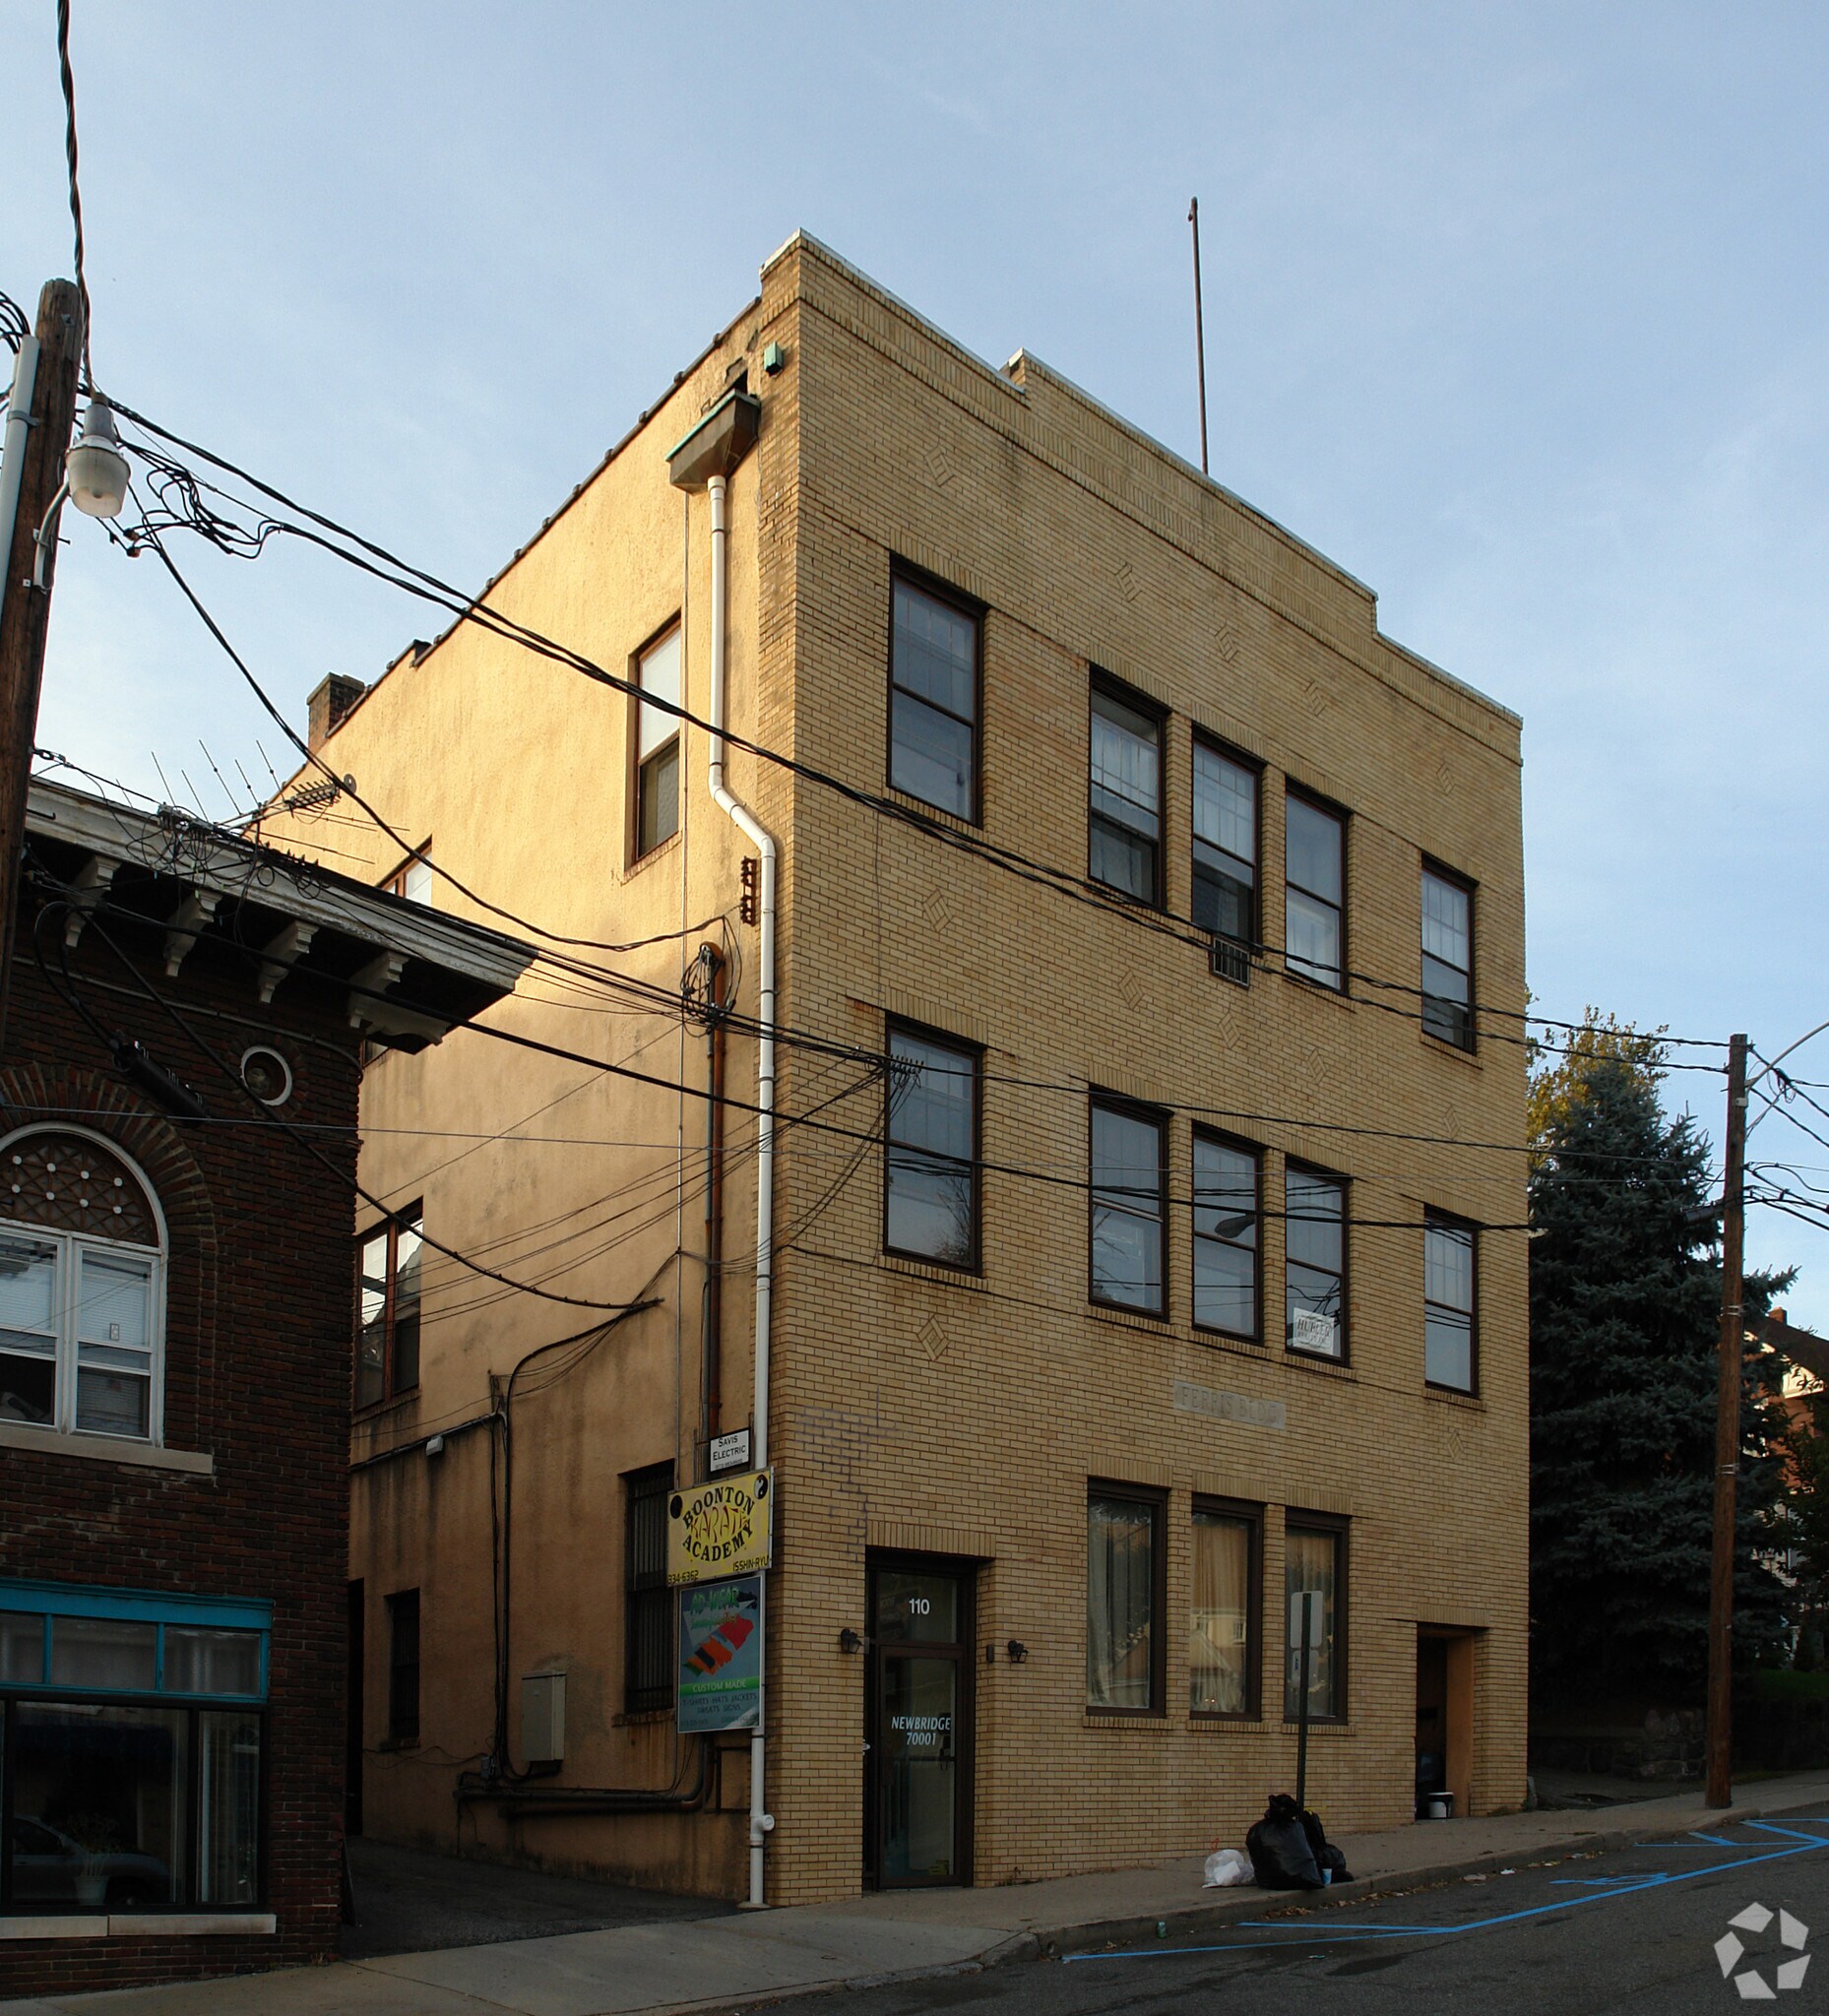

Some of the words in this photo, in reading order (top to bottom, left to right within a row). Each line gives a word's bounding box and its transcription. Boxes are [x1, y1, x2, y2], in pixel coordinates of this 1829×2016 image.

[719, 1435, 738, 1447] SAVIS
[714, 1445, 746, 1460] ELECTRIC
[682, 1486, 755, 1529] BOONTON
[690, 1505, 747, 1544] KARATE
[682, 1518, 753, 1561] ACADEMY
[910, 1598, 930, 1615] 110
[692, 1682, 723, 1693] CUSTOM
[725, 1679, 746, 1689] MADE
[891, 1716, 951, 1731] NEWBRIDGE
[906, 1732, 936, 1745] 70001
